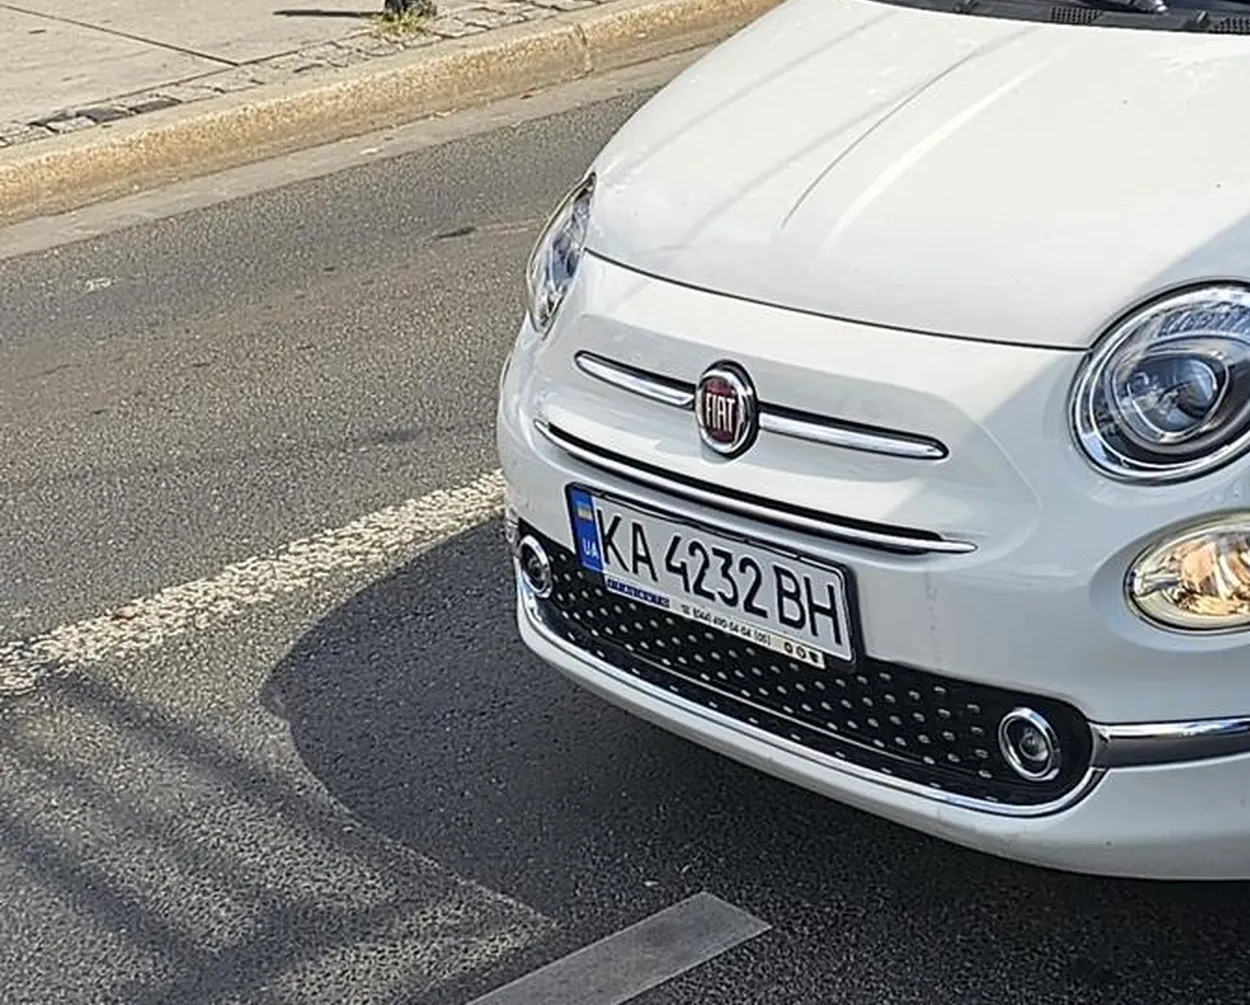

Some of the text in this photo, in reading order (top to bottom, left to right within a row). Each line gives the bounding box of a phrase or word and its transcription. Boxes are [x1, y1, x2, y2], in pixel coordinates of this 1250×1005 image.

[705, 391, 736, 433] FIAT
[581, 537, 600, 560] UA
[596, 508, 843, 646] KA 4232 BH
